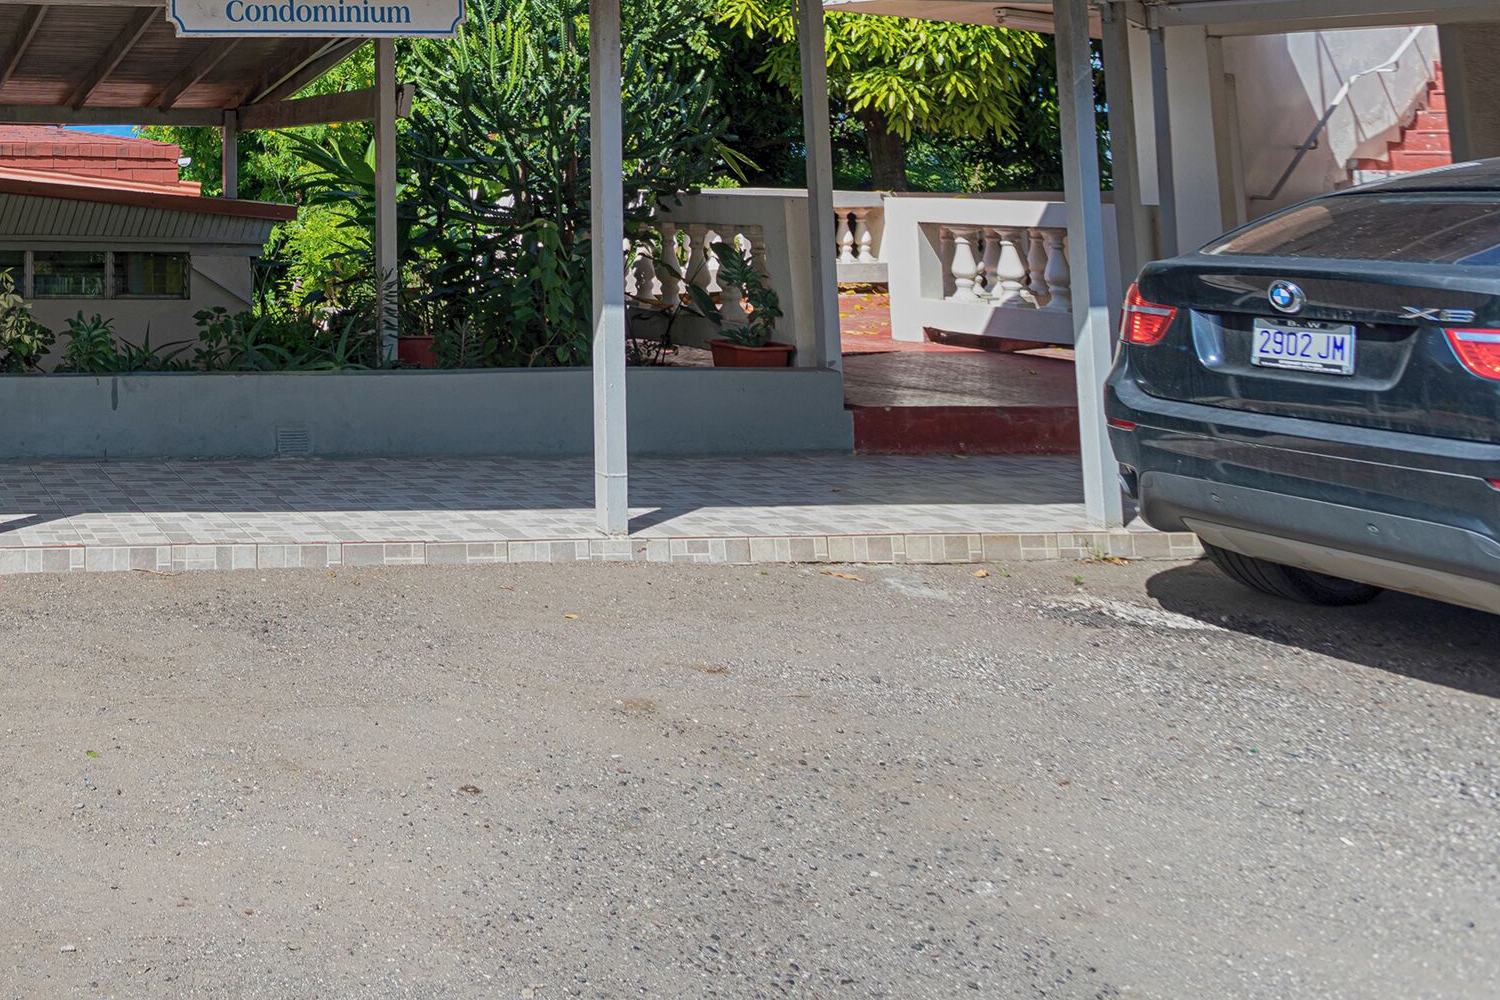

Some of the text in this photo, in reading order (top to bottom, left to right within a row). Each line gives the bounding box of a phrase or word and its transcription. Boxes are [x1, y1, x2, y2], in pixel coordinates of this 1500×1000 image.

[225, 0, 411, 24] Condominium
[1259, 330, 1345, 361] 2902 JM
